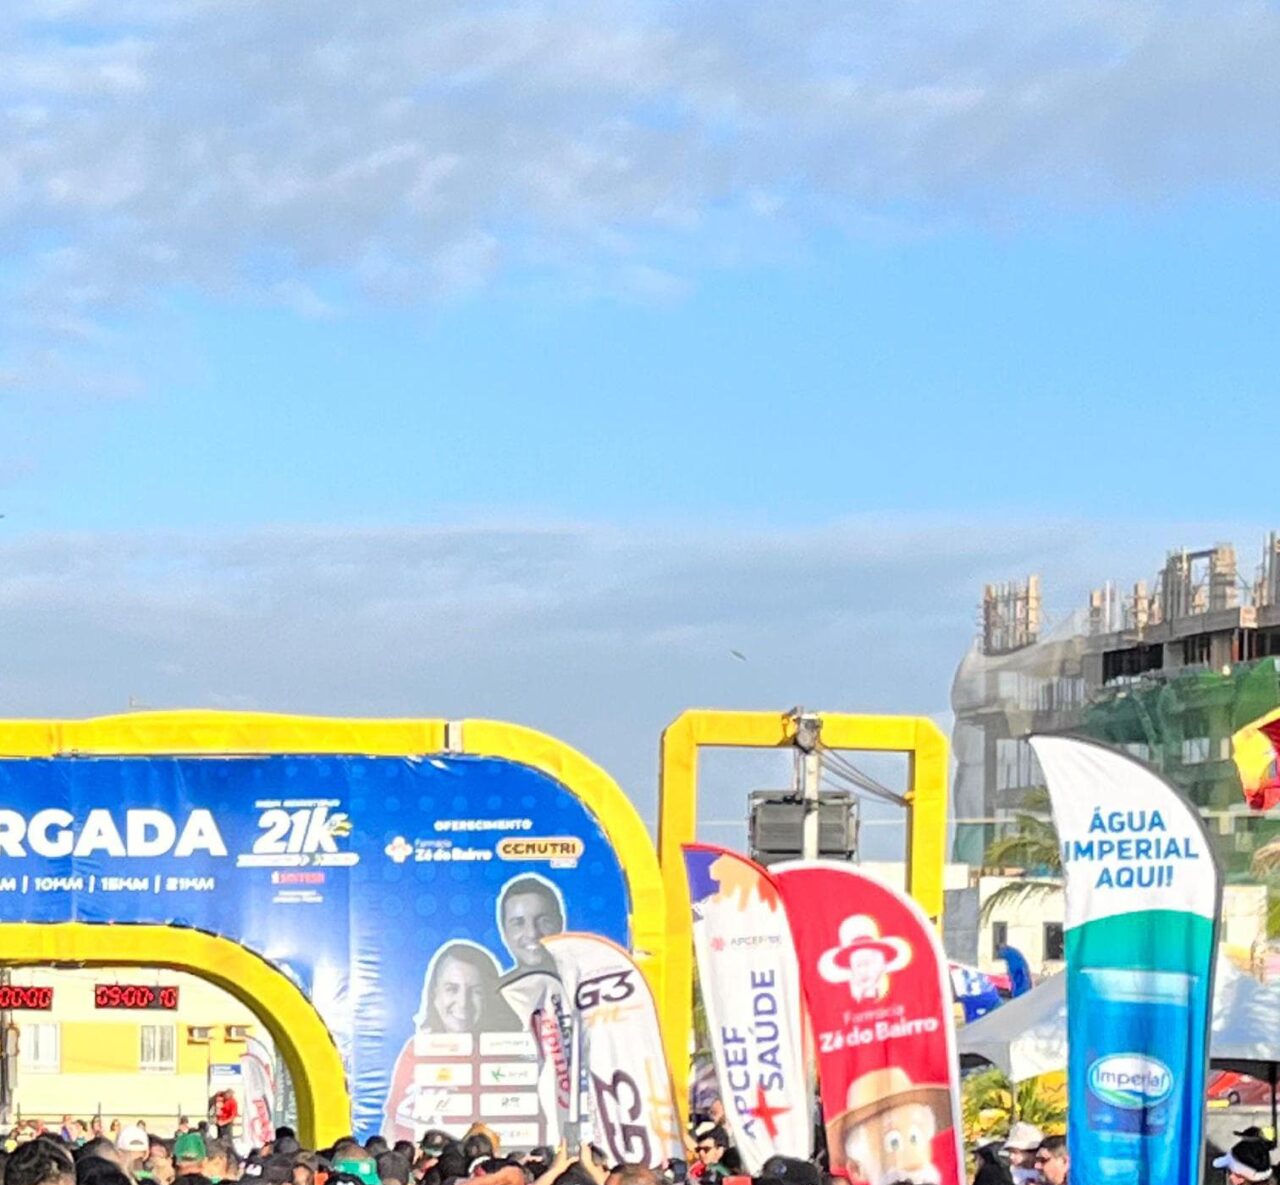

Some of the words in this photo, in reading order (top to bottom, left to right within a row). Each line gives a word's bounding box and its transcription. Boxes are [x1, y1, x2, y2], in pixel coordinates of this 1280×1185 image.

[433, 818, 534, 832] OFERECIMENTO
[1088, 806, 1167, 833] ÁGUA
[1064, 837, 1200, 863] IMPERIAL
[34, 876, 84, 892] 10KM
[1094, 865, 1174, 889] AQUI!
[749, 969, 784, 1092] SAÚDE
[846, 1025, 873, 1048] do
[875, 1017, 938, 1042] Bairro
[1095, 1067, 1166, 1090] Imperial
